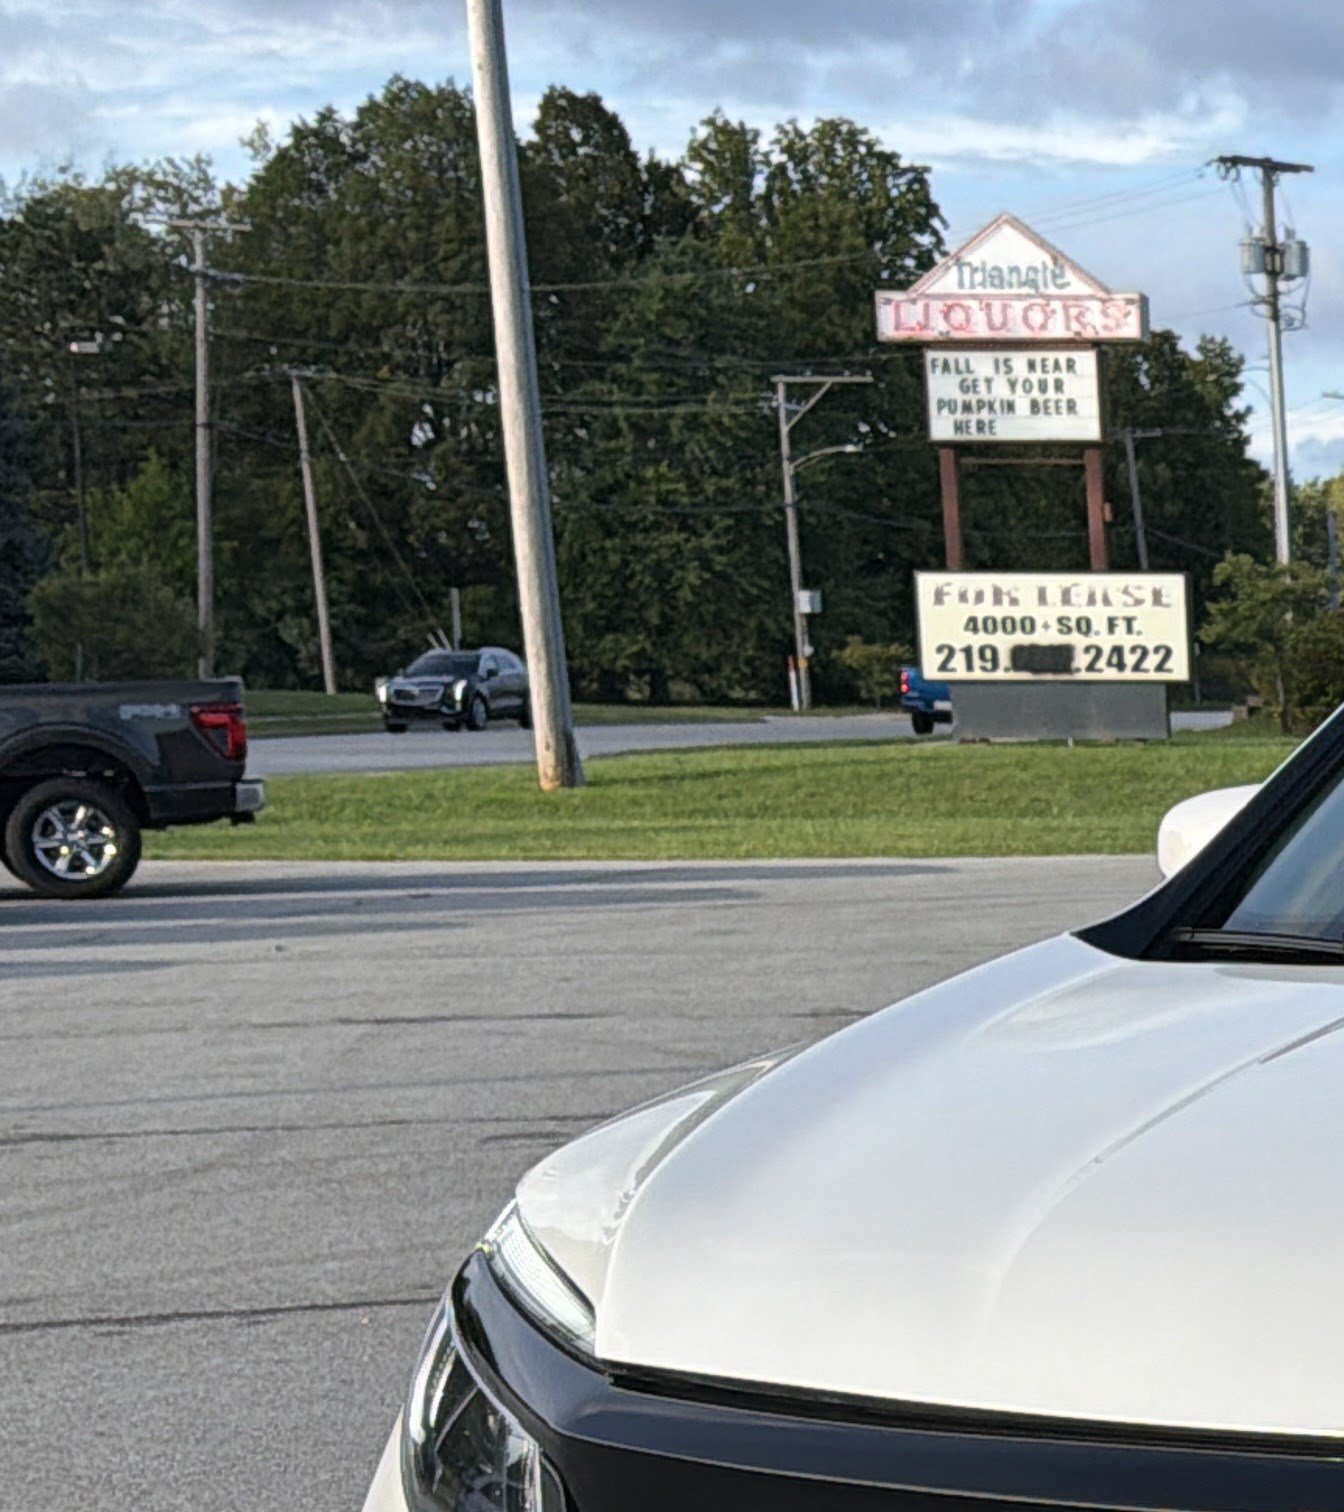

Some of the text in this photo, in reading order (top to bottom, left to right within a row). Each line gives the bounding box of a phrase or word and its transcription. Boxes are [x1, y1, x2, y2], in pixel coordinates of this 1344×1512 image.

[954, 260, 1072, 292] Triangle
[891, 299, 1132, 333] LIQUORS
[930, 356, 1077, 375] FALL IS NEAR
[959, 378, 1065, 395] GET YOUR
[936, 398, 1078, 416] PUMPKIN BEER
[953, 419, 997, 436] HERE
[1056, 616, 1101, 638] SQ.
[1107, 616, 1143, 636] FT.
